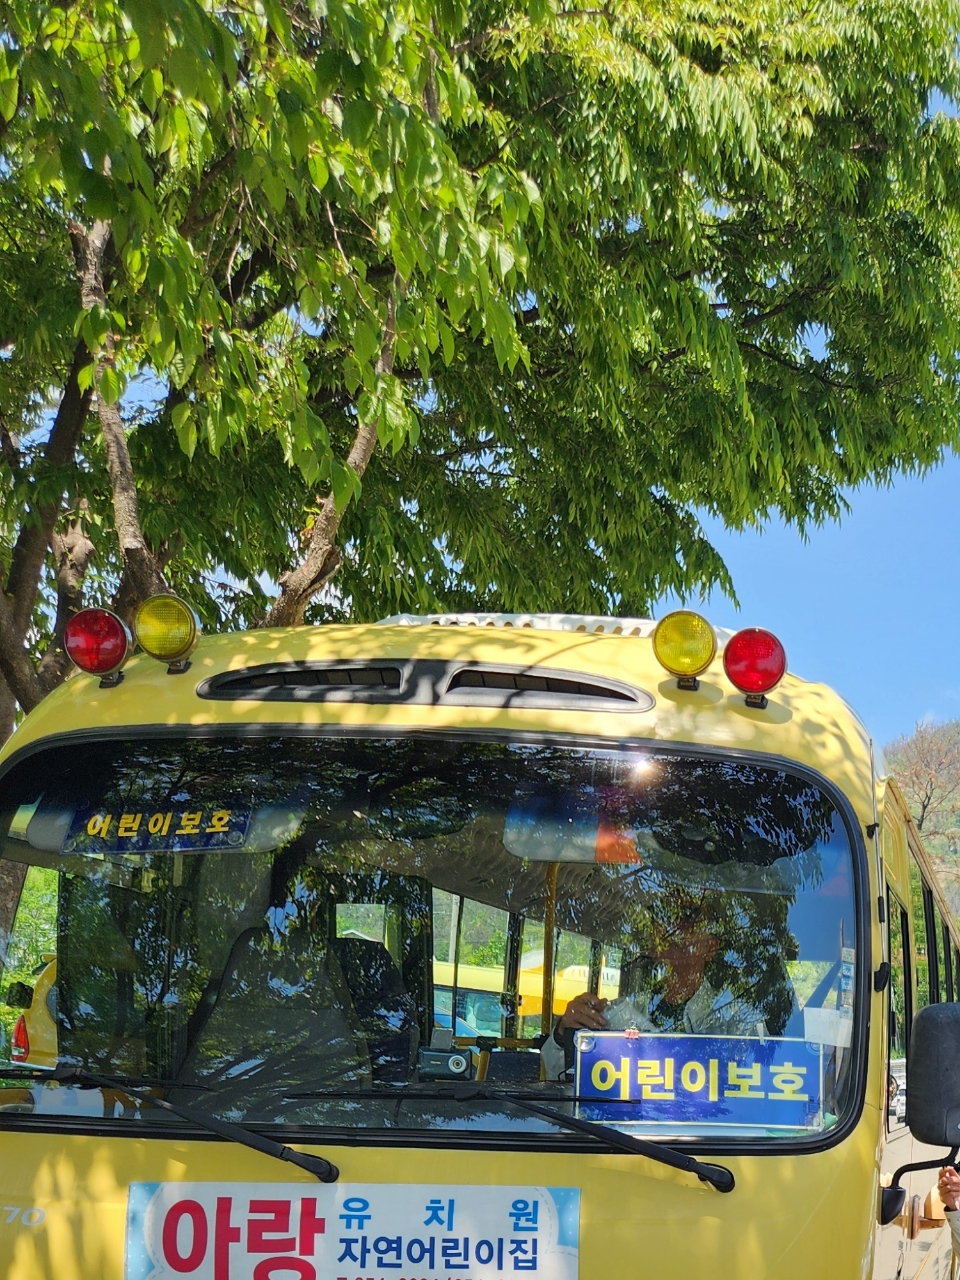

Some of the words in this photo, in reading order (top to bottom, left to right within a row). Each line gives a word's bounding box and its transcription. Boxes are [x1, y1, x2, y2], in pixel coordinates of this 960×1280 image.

[86, 809, 232, 838] 어린이보호
[591, 1057, 809, 1102] 어린이보호
[337, 1235, 539, 1271] 자연어린이집
